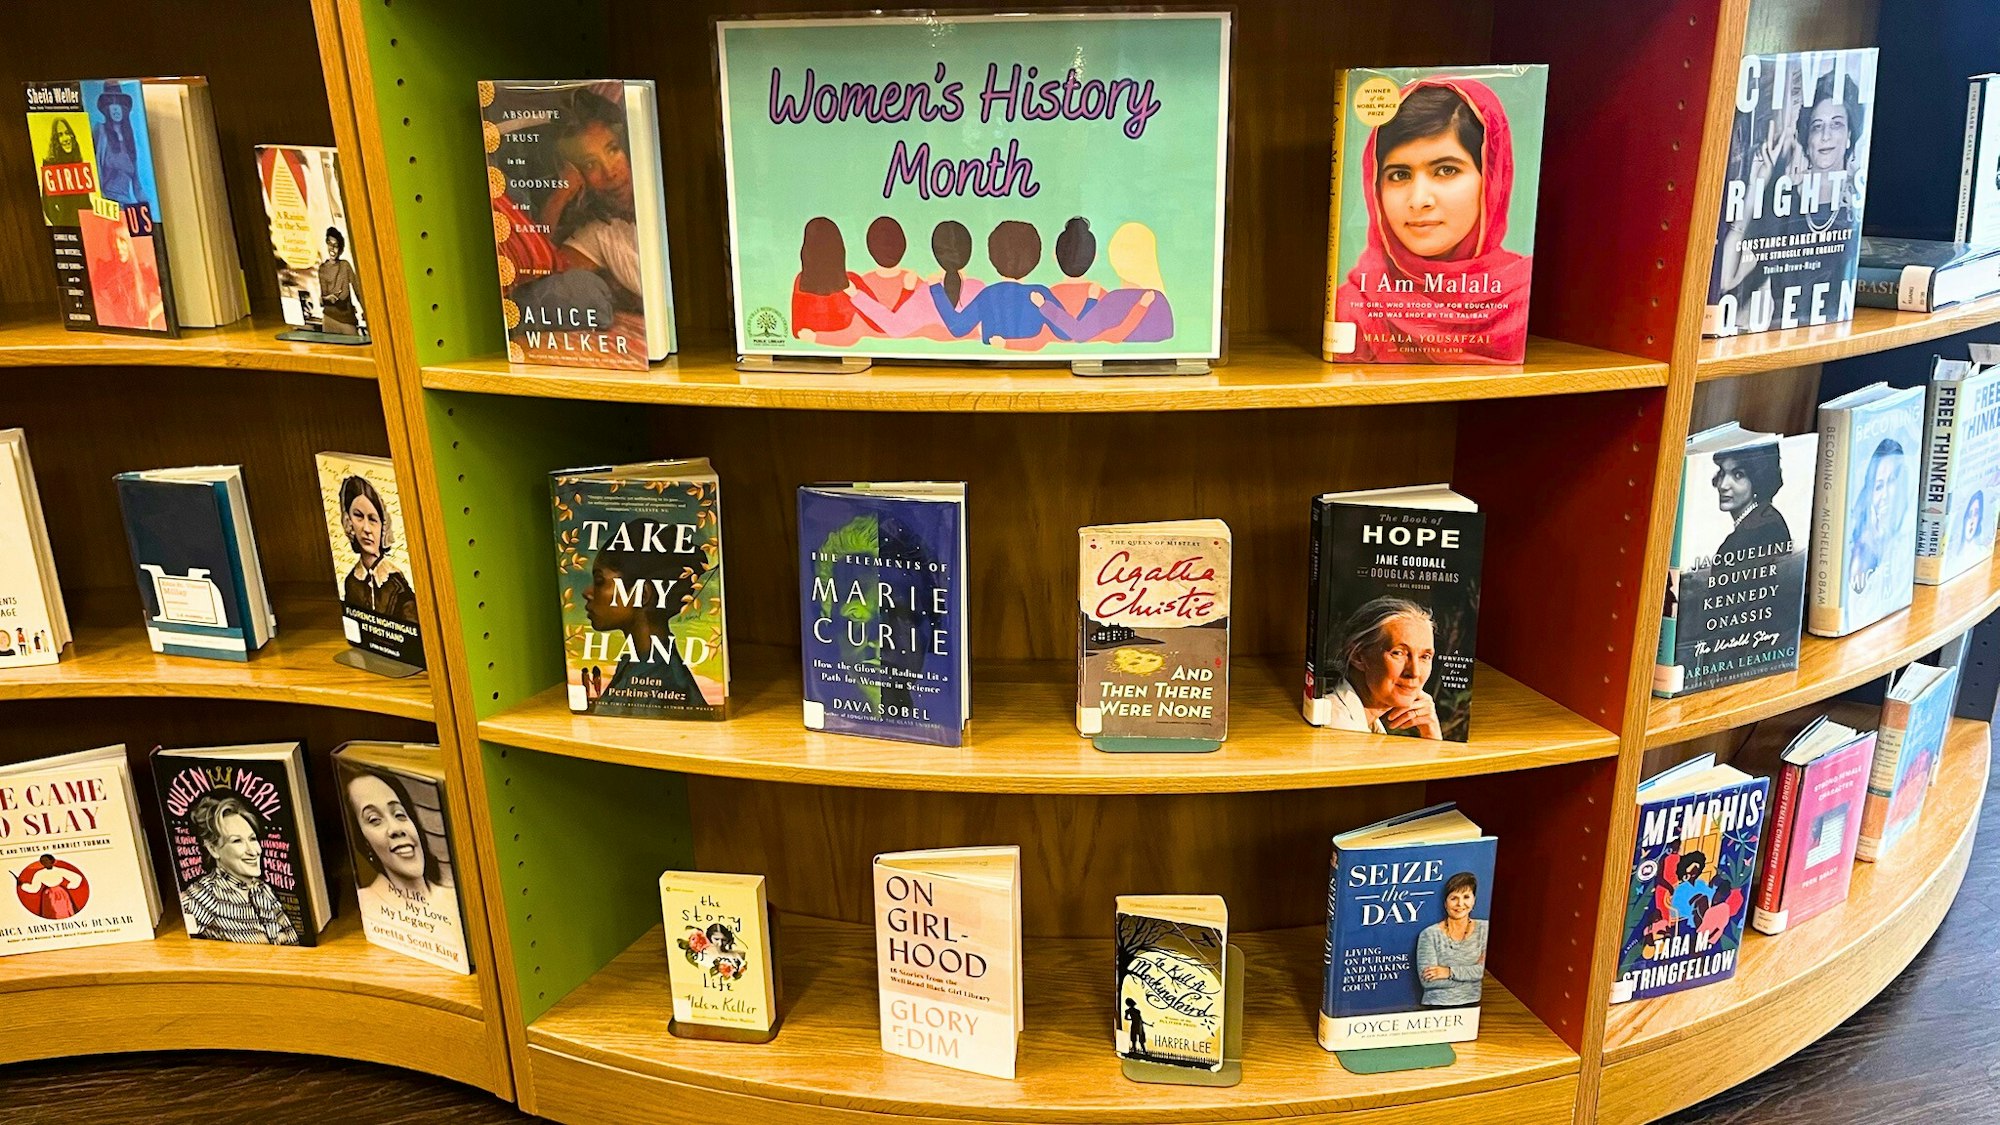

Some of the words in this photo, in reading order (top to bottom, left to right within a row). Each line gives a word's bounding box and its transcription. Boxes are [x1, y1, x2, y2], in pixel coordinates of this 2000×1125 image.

[26, 88, 53, 104] Sheila
[52, 87, 79, 104] Weller
[769, 61, 965, 126] Women's
[980, 63, 1161, 139] History
[502, 110, 560, 119] ABSOLUTE
[505, 133, 540, 143] TRUST
[44, 166, 93, 192] GIRLS
[883, 138, 1040, 199] Month
[510, 179, 570, 189] GOODNESS
[1725, 168, 1867, 223] RIGHTS
[94, 199, 118, 219] LIKE
[127, 205, 153, 234] US
[515, 223, 551, 234] EARTH
[1735, 235, 1787, 252] CONSTANCE
[1788, 232, 1818, 247] BAKER
[1818, 228, 1854, 244] MOTLEY
[1769, 248, 1802, 261] STRUGGLE
[1802, 246, 1814, 257] FOR
[1359, 272, 1367, 293] I
[1376, 272, 1414, 293] Am
[1423, 272, 1503, 294] Malala
[524, 305, 598, 327] ALICE
[1350, 301, 1364, 309] THE
[1366, 301, 1385, 309] GIRL
[1446, 302, 1463, 310] FOR
[1464, 302, 1509, 310] EDUCATION
[1718, 278, 1857, 338] QUEEN
[525, 330, 628, 354] WALKER
[1363, 333, 1413, 344] MALALA
[1419, 333, 1491, 344] YOUSAFZAI
[1937, 387, 1957, 428] FREE
[1823, 426, 1837, 491] BECOMING
[1928, 434, 1951, 503] THINKER
[1379, 513, 1398, 523] The
[1401, 514, 1428, 524] Book
[1430, 516, 1444, 526] of
[582, 520, 697, 554] TAKE
[1362, 524, 1461, 550] HOPE
[1819, 507, 1832, 566] MICHELLE
[811, 552, 838, 563] THE
[846, 554, 921, 571] ELEMENTS
[928, 562, 948, 573] OF
[1375, 553, 1399, 566] JANE
[1401, 555, 1447, 569] GOODALL
[1692, 540, 1795, 574] JACQUELINE
[1096, 550, 1216, 592] Agatha
[1370, 567, 1416, 580] DOUGLAS
[1418, 570, 1460, 584] ABRAMS
[1708, 563, 1778, 589] BOUVIER
[609, 577, 677, 610] MY
[811, 576, 949, 615] MARIE
[1703, 584, 1780, 611] KENNEDY
[1817, 569, 1828, 606] OBAM
[1095, 586, 1216, 620] Christie
[345, 606, 376, 624] FLORENCE
[376, 617, 419, 637] NIGHTINGALE
[1706, 606, 1774, 632] ONASSIS
[813, 616, 949, 656] CURIE
[1713, 632, 1751, 653] Untold
[1752, 630, 1780, 648] Story
[581, 631, 710, 667] HAND
[1738, 646, 1796, 668] LEAMING
[813, 659, 833, 669] How
[837, 661, 852, 671] the
[854, 663, 876, 674] Glow
[879, 666, 889, 675] of
[891, 667, 924, 680] Radium
[926, 671, 940, 681] Lit
[1171, 664, 1214, 682] AND
[1443, 661, 1467, 670] GUIDE
[630, 676, 663, 687] Dolen
[821, 672, 842, 682] Path
[845, 674, 856, 684] for
[859, 676, 892, 689] Women
[894, 680, 904, 690] in
[906, 681, 941, 694] Science
[1100, 681, 1149, 699] THEN
[1154, 681, 1214, 701] THERE
[608, 687, 687, 701] Perkins-Valdez
[833, 698, 872, 713] DAVA
[877, 703, 931, 721] SOBEL
[1099, 700, 1153, 718] WERE
[1157, 701, 1213, 719] NONE
[25, 778, 108, 808] CAME
[166, 766, 212, 817] QUEEN
[234, 767, 282, 822] MERYL
[1782, 771, 1793, 801] STRONG
[23, 806, 100, 837] SLAY
[1642, 788, 1764, 849] MEMPHIS
[1777, 801, 1789, 828] FEMALE
[19, 845, 40, 854] TIMES
[52, 841, 82, 850] HARRIET
[83, 838, 111, 847] TUBMAN
[1771, 828, 1784, 870] CHARACTER
[263, 857, 294, 876] MERYL
[1348, 859, 1444, 889] SEIZE
[264, 869, 296, 891] STREEP
[886, 875, 934, 907] ON
[1767, 874, 1776, 893] FERN
[405, 886, 430, 906] Life,
[700, 895, 721, 908] the
[1381, 884, 1410, 903] the
[27, 919, 88, 935] ARMSTRONG
[91, 915, 134, 928] DUNBAR
[380, 905, 396, 921] My
[398, 910, 436, 933] Legacy
[405, 901, 421, 917] My
[423, 906, 452, 926] Love,
[887, 907, 969, 943] GIRL-
[1361, 900, 1426, 927] DAY
[407, 932, 434, 951] Scott
[435, 943, 460, 962] King
[889, 937, 988, 979] HOOD
[1345, 946, 1382, 958] LIVING
[1653, 933, 1690, 962] TARA
[1695, 930, 1713, 953] M.
[1343, 966, 1367, 976] AND
[1369, 962, 1410, 973] MAKING
[1344, 957, 1359, 967] ON
[1361, 953, 1409, 965] PURPOSE
[899, 969, 925, 980] Stories
[926, 974, 944, 984] from
[1342, 982, 1378, 993] COUNT
[1343, 973, 1378, 984] EVERY
[1379, 971, 1400, 981] DAY
[926, 983, 946, 993] Black
[947, 987, 962, 996] Girl
[963, 989, 991, 1003] Library
[722, 997, 757, 1015] Keller
[891, 999, 979, 1037] GLORY
[1346, 1019, 1400, 1038] JOYCE
[1406, 1014, 1464, 1030] MEYER
[1154, 1034, 1191, 1051] HARPER
[1192, 1040, 1212, 1054] LEE
